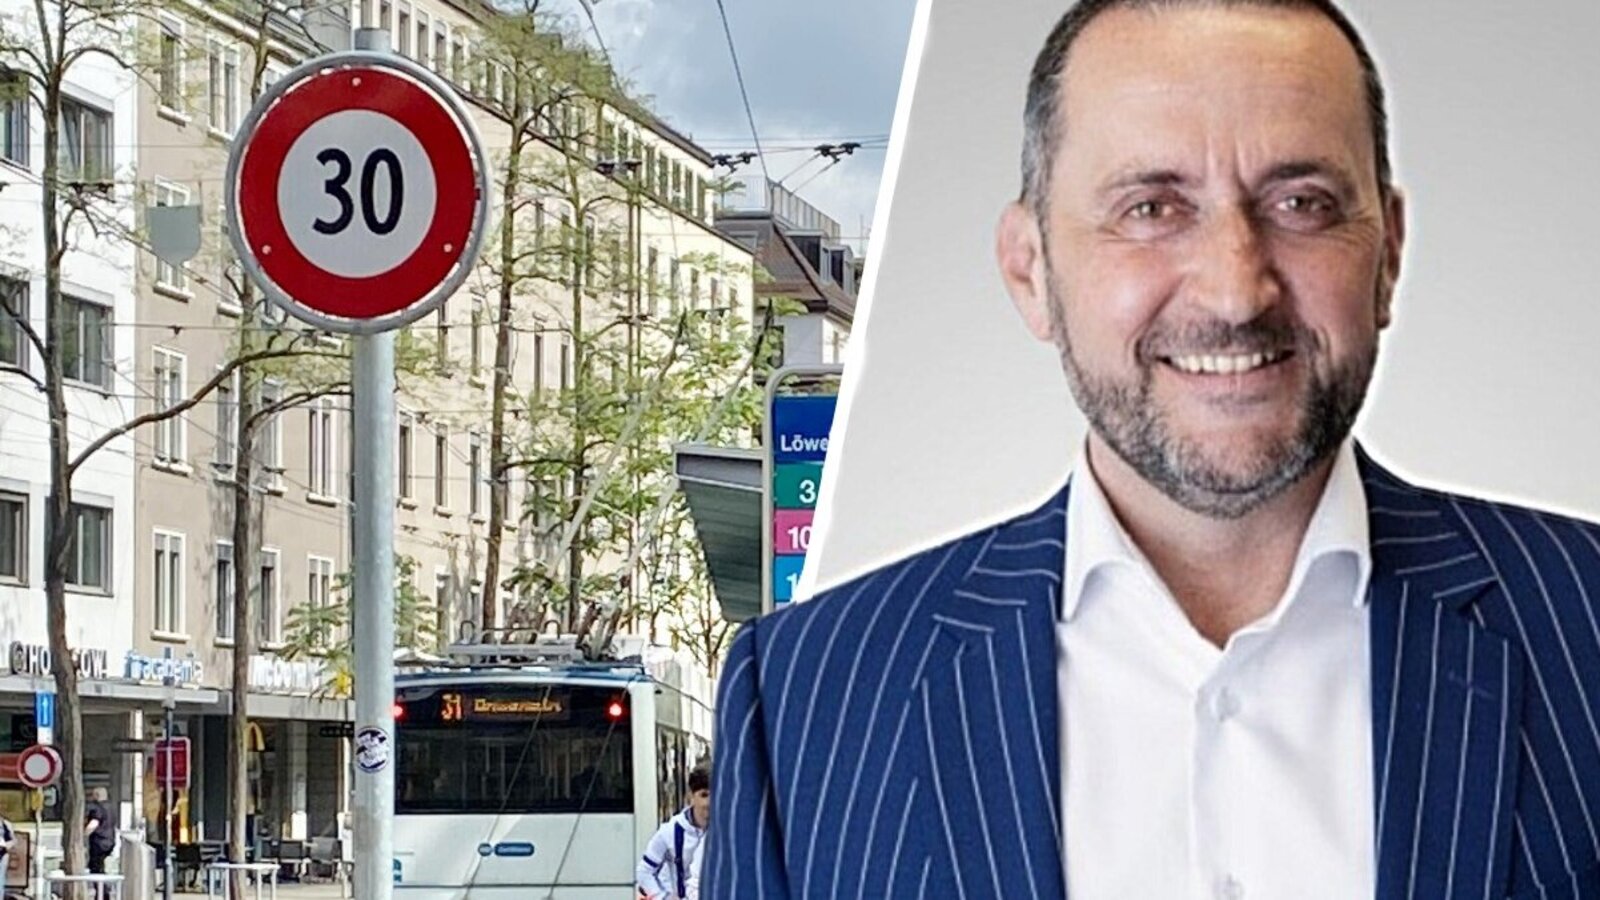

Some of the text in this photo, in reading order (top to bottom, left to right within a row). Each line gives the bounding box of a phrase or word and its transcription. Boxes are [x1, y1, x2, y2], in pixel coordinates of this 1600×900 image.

[313, 148, 404, 235] 30
[780, 434, 828, 452] Löwe
[799, 479, 816, 504] 3
[787, 525, 811, 550] 10
